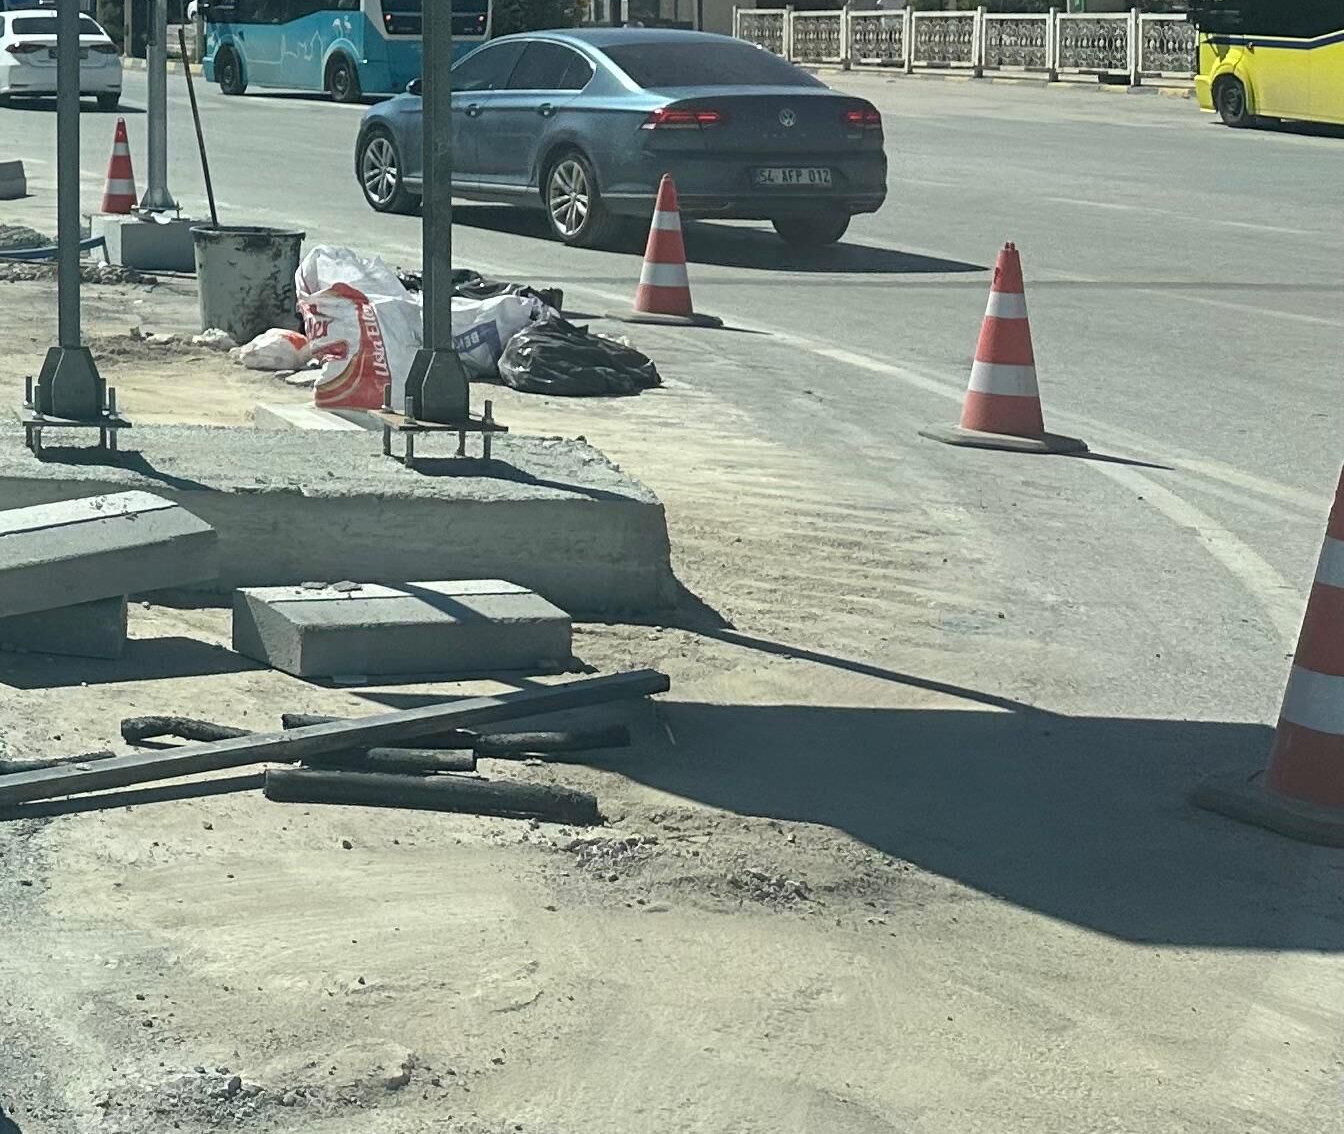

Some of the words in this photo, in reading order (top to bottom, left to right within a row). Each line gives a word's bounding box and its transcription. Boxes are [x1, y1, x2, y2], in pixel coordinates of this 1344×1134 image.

[759, 169, 774, 183] 54
[782, 169, 802, 183] AFP
[808, 169, 830, 183] 012
